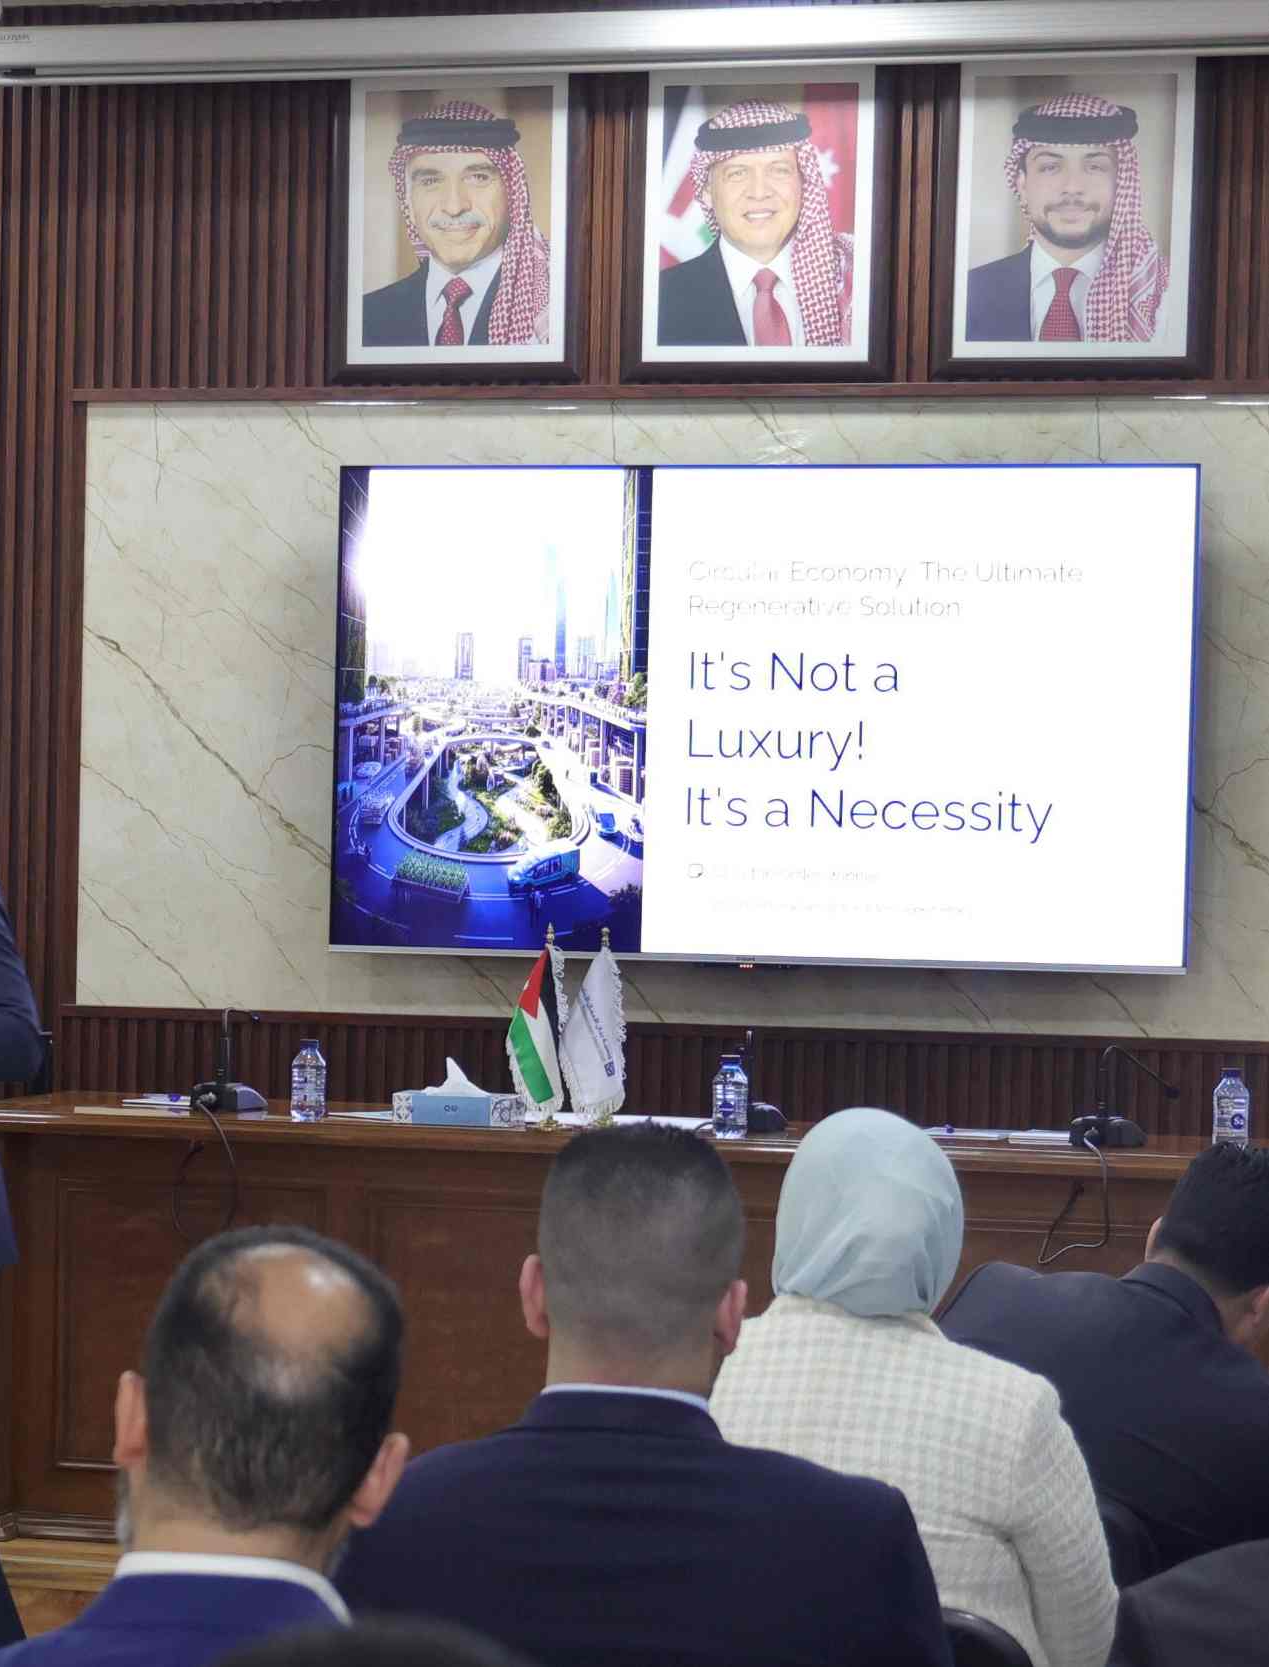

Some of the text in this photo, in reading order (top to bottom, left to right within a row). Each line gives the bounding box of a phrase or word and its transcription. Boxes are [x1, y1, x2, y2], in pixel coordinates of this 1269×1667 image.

[920, 560, 967, 582] The
[977, 560, 1082, 583] Ultimate
[688, 595, 962, 621] Regenerative Solution
[690, 651, 898, 692] It's Not a
[689, 719, 863, 771] Luxury!
[687, 787, 1052, 844] It's a Necessity
